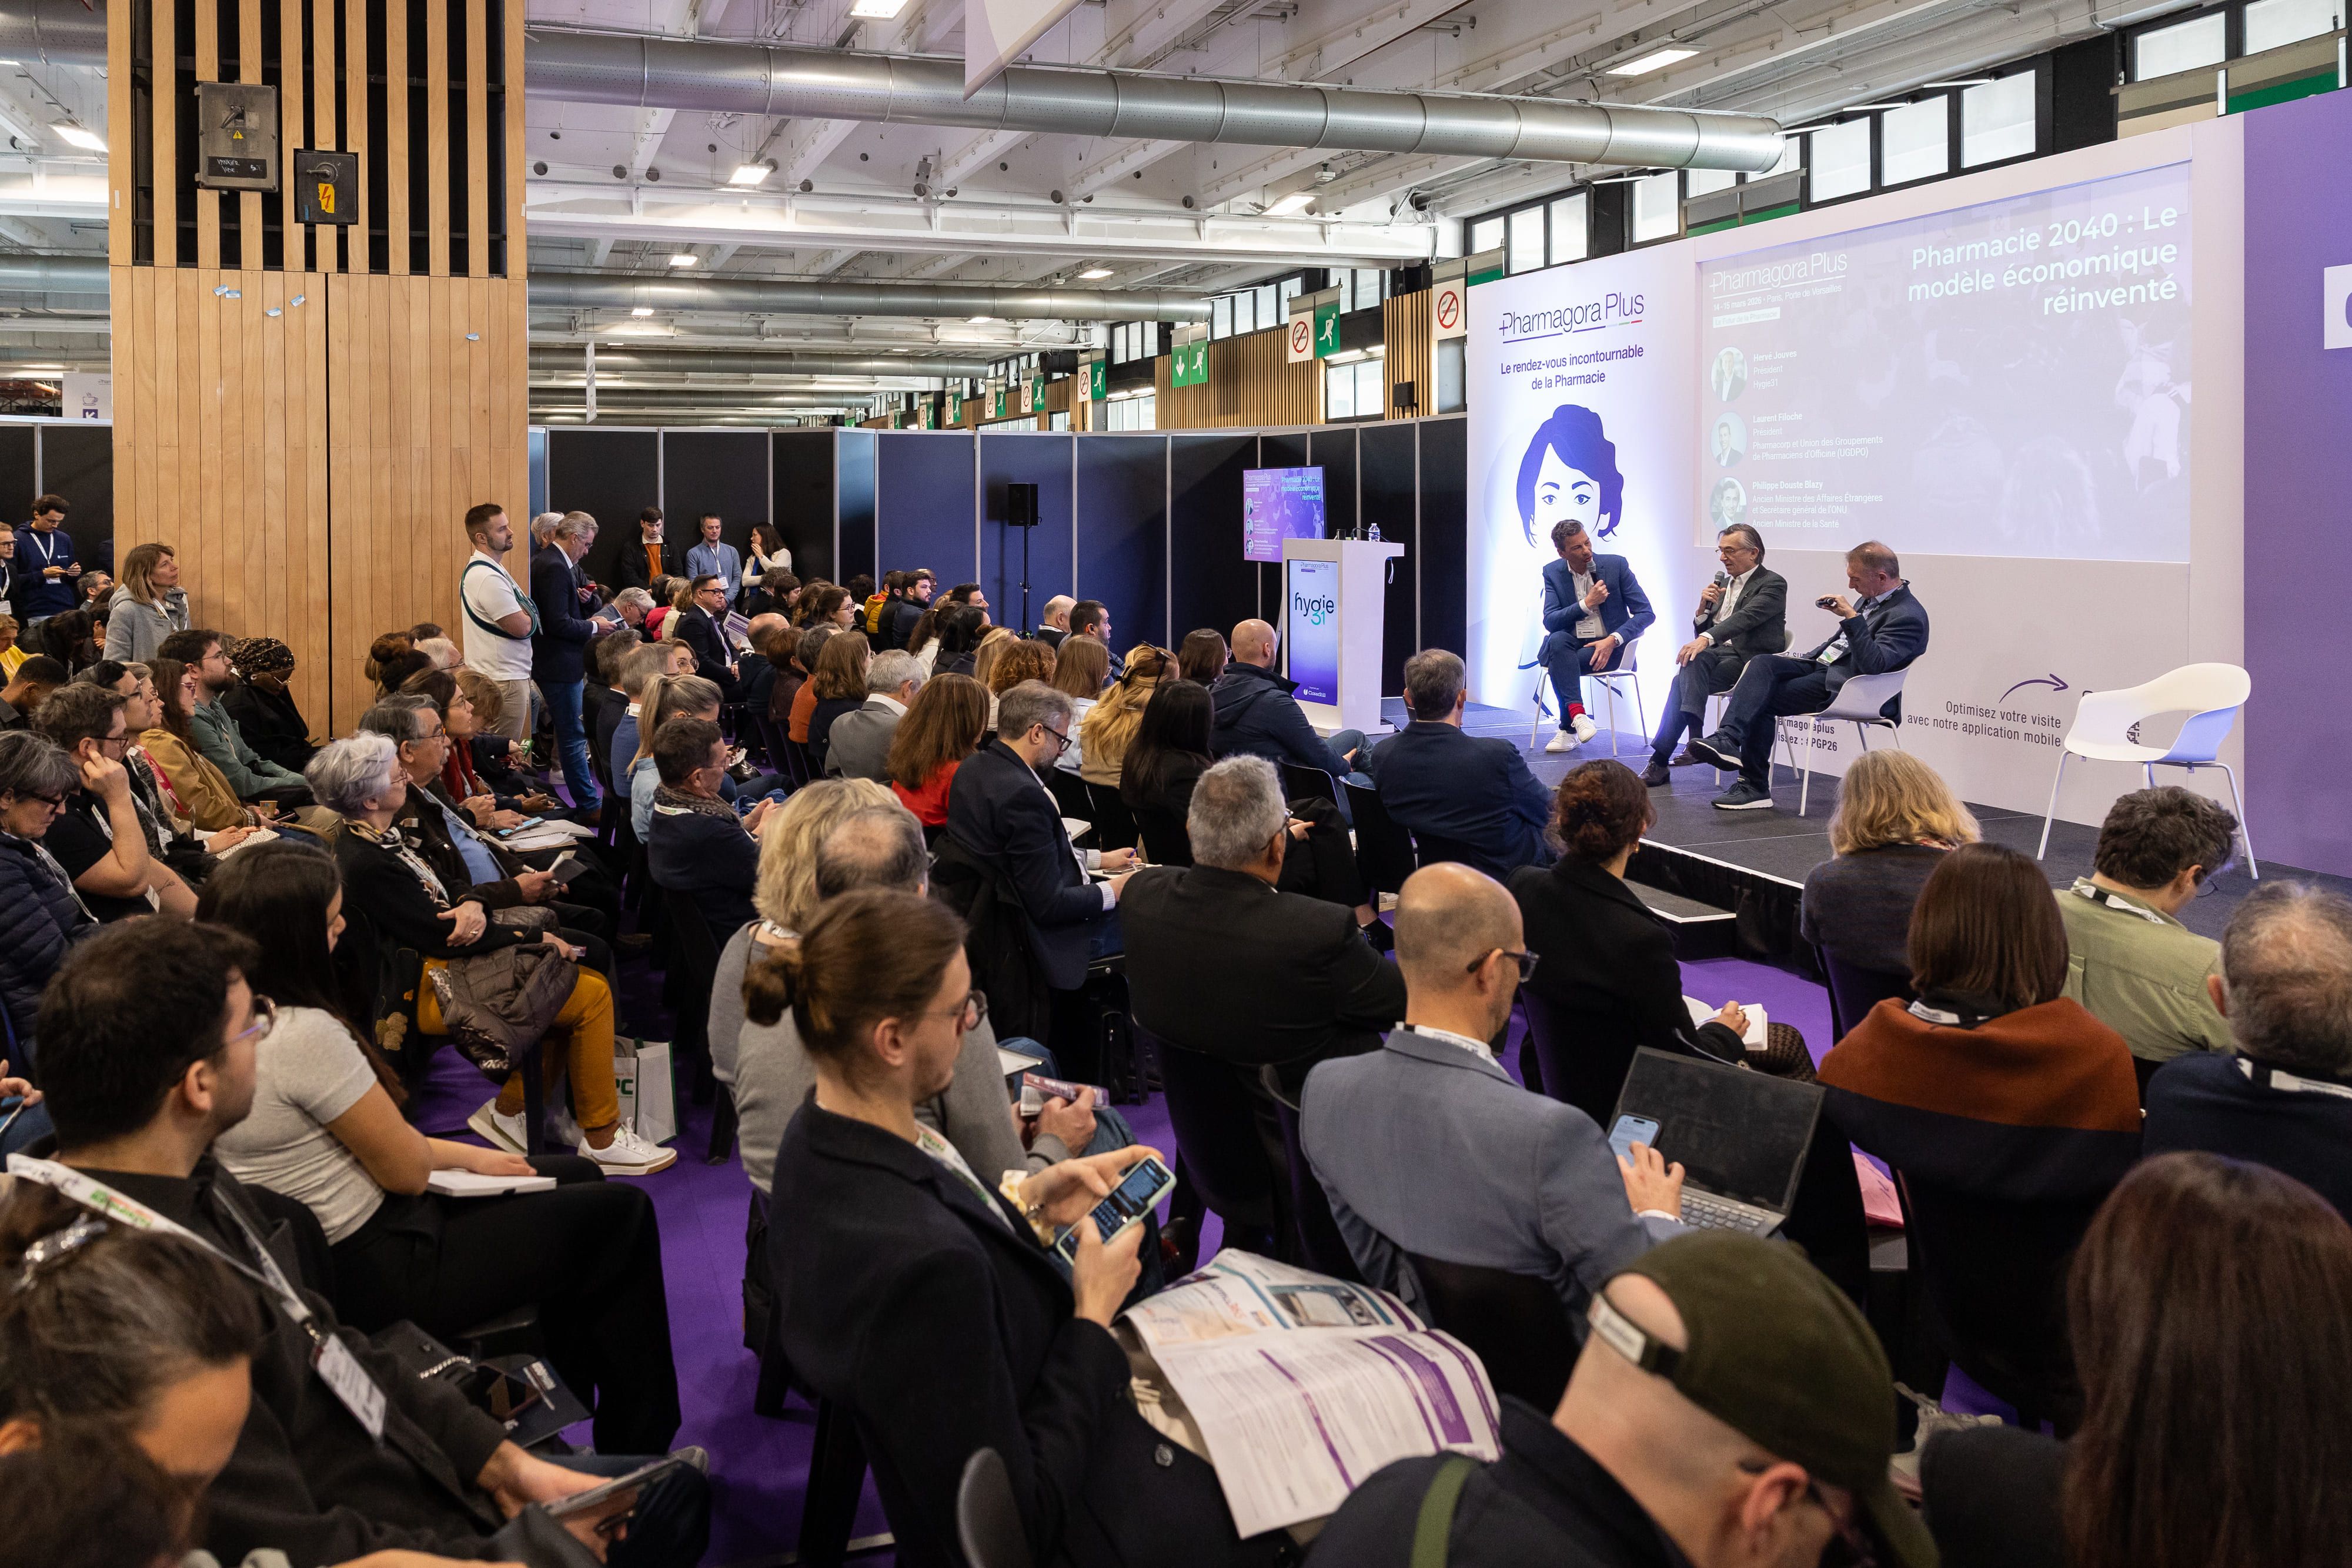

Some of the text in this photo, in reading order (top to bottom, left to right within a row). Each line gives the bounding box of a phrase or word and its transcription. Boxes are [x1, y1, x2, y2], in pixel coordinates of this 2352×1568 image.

[1912, 206, 2178, 270] Pharmacie 2040 : Le
[1709, 252, 1847, 293] Pharmagora Plus
[1908, 243, 2177, 302] modèle économique
[1748, 296, 1762, 305] 2026
[1767, 293, 1783, 303] Paris,
[1785, 290, 1801, 300] Porte
[1802, 289, 1810, 297] de
[1812, 284, 1842, 296] Versailles
[2044, 273, 2177, 315] réinventé
[1499, 292, 1644, 336] Pharmagora Plus
[1501, 345, 1643, 375] Le rendez-vous incontournable
[1753, 350, 1797, 362] Hervé Jouves
[1753, 365, 1783, 375] Président
[1532, 370, 1605, 390] de la Pharmacie
[1753, 379, 1778, 390] Hygie31
[1753, 412, 1803, 423] Laurent Filoche
[1753, 427, 1783, 437] Président
[1753, 440, 1791, 450] Pharmacorp
[1800, 439, 1820, 447] Union
[1821, 437, 1834, 446] des
[1835, 436, 1883, 447] Groupements
[1753, 452, 1761, 461] de
[1762, 450, 1803, 460] Pharmaciens
[1837, 446, 1869, 459] (UGDPO)
[1752, 480, 1823, 492] Philippe Douste Blazy
[1752, 491, 1883, 504] Ancien Ministre des Affaires Étrangères
[1759, 506, 1791, 514] Secrétaire
[1792, 506, 1816, 516] général
[1818, 506, 1826, 514] de
[1753, 518, 1839, 528] Ancien Ministre de la Santé
[1295, 592, 1334, 617] hygie
[1311, 611, 1325, 626] 31
[1946, 700, 2061, 729] Optimisez votre visite
[1907, 714, 2061, 747] avec notre application mobile
